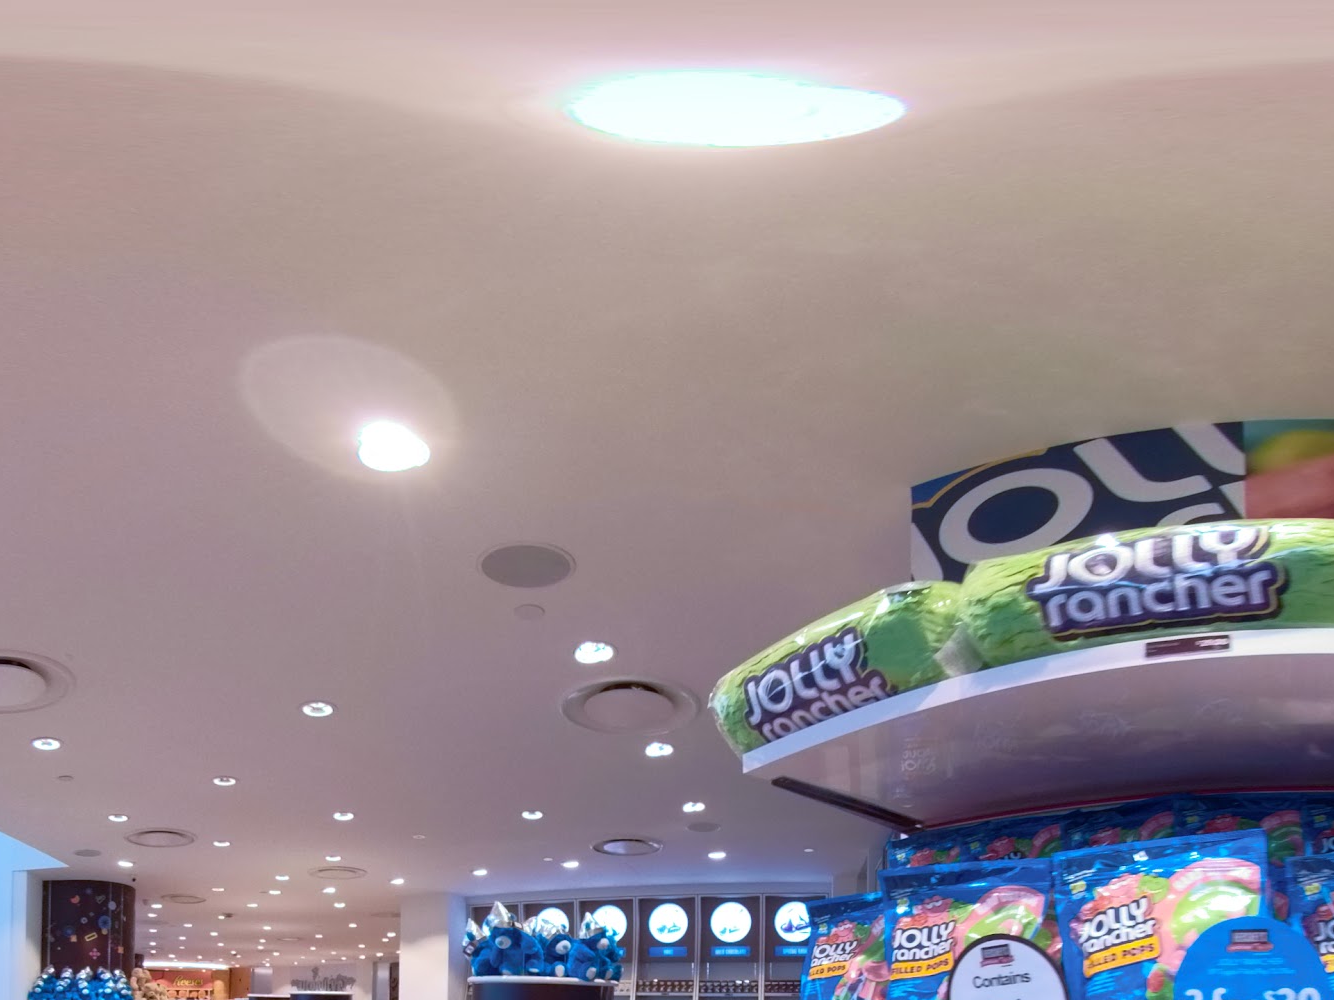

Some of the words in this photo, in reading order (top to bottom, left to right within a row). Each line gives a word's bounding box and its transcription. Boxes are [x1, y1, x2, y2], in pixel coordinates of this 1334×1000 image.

[1033, 526, 1259, 593] JOLLY
[1045, 569, 1273, 628] rancher
[745, 633, 857, 726] JOLLY
[1078, 896, 1149, 943] JOLLY
[893, 920, 957, 948] JOLLY
[892, 938, 955, 961] rancher
[1121, 943, 1155, 960] POPS
[926, 958, 950, 971] POPS
[972, 971, 1032, 989] Contains
